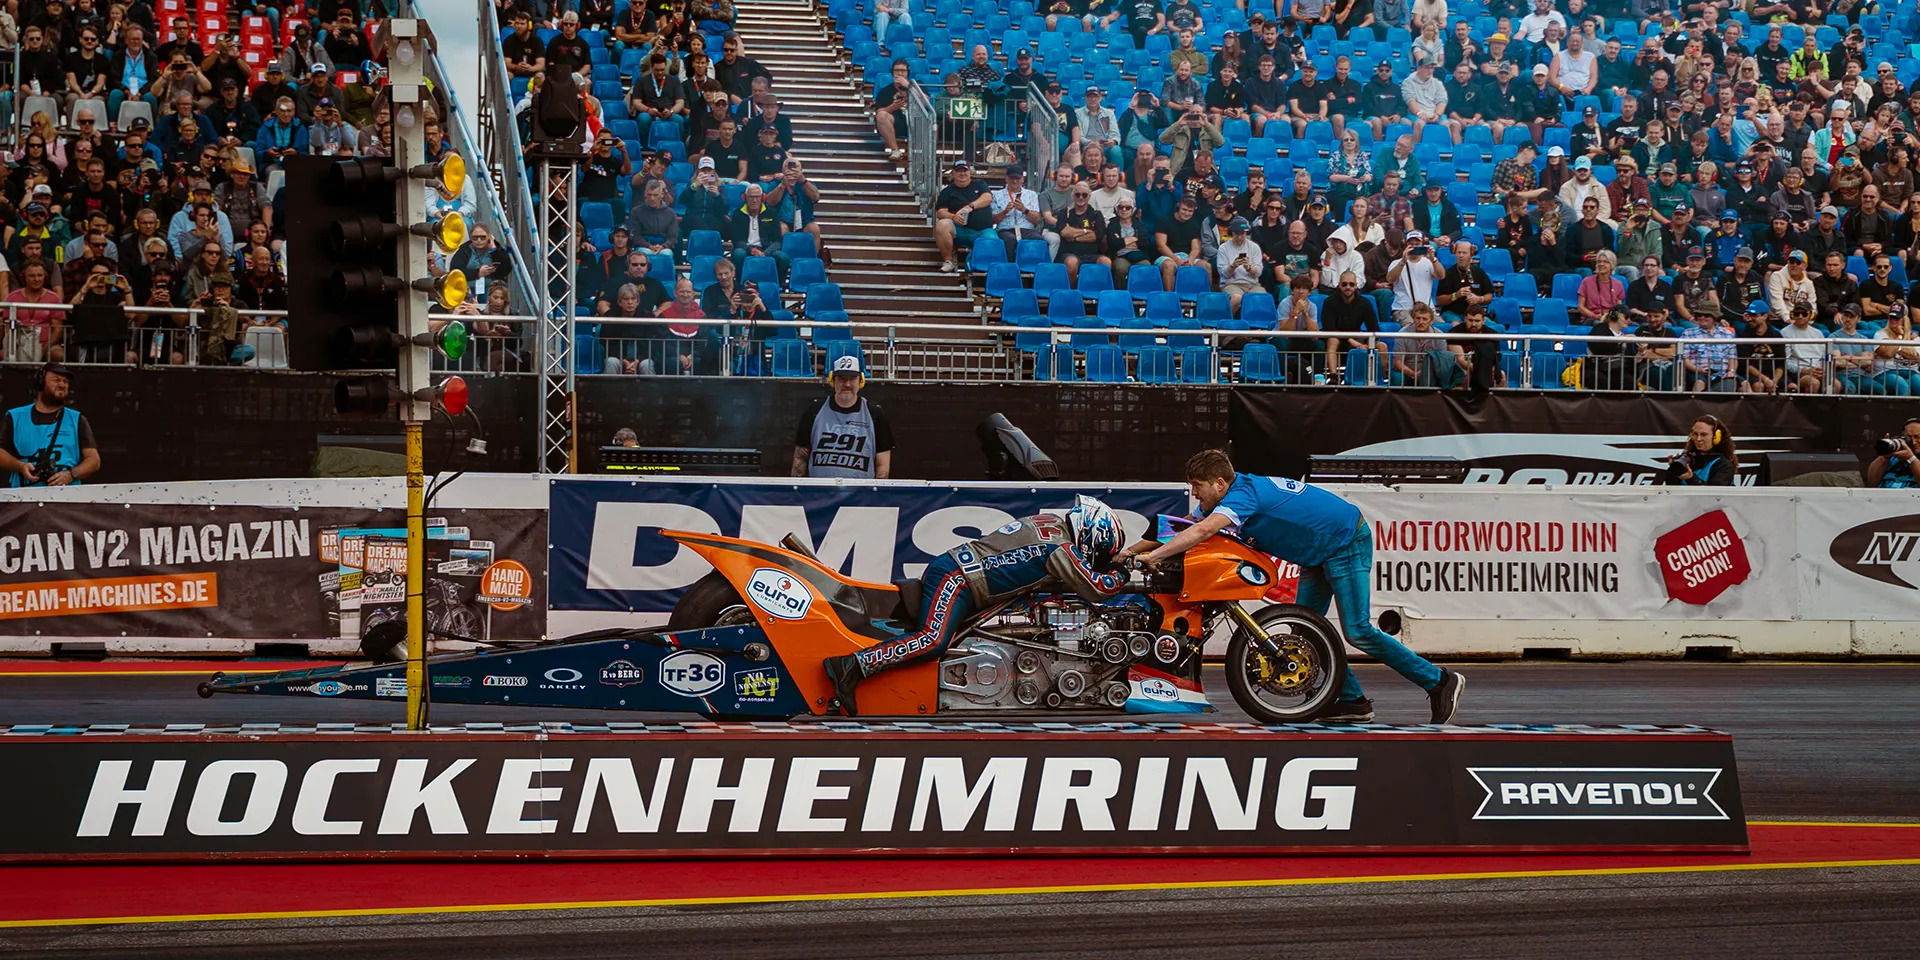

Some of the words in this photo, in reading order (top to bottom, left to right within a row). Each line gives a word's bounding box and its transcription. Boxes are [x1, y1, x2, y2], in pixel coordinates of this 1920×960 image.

[817, 432, 866, 452] 291
[815, 454, 864, 469] MEDIA
[1375, 520, 1564, 552] MOTORWORLD
[1572, 522, 1617, 552] INN
[0, 532, 74, 574] CAN
[84, 530, 130, 569] V2
[139, 519, 310, 566] MAGAZIN
[343, 540, 365, 552] DRE
[367, 546, 408, 559] DREAM
[1667, 528, 1731, 571] COMING
[367, 558, 407, 573] MACHINES
[1683, 551, 1733, 588] SOON!
[491, 568, 524, 584] HAND
[1376, 561, 1618, 593] HOCKENHEIMRING
[363, 591, 404, 600] NIGHTSTER
[489, 582, 523, 596] MADE
[753, 580, 806, 612] eurol
[497, 676, 528, 686] BOKO
[617, 670, 640, 678] BERG
[665, 664, 720, 682] TF36
[1144, 686, 1176, 698] eurol
[76, 757, 1358, 837] HOCKENHEIMRING
